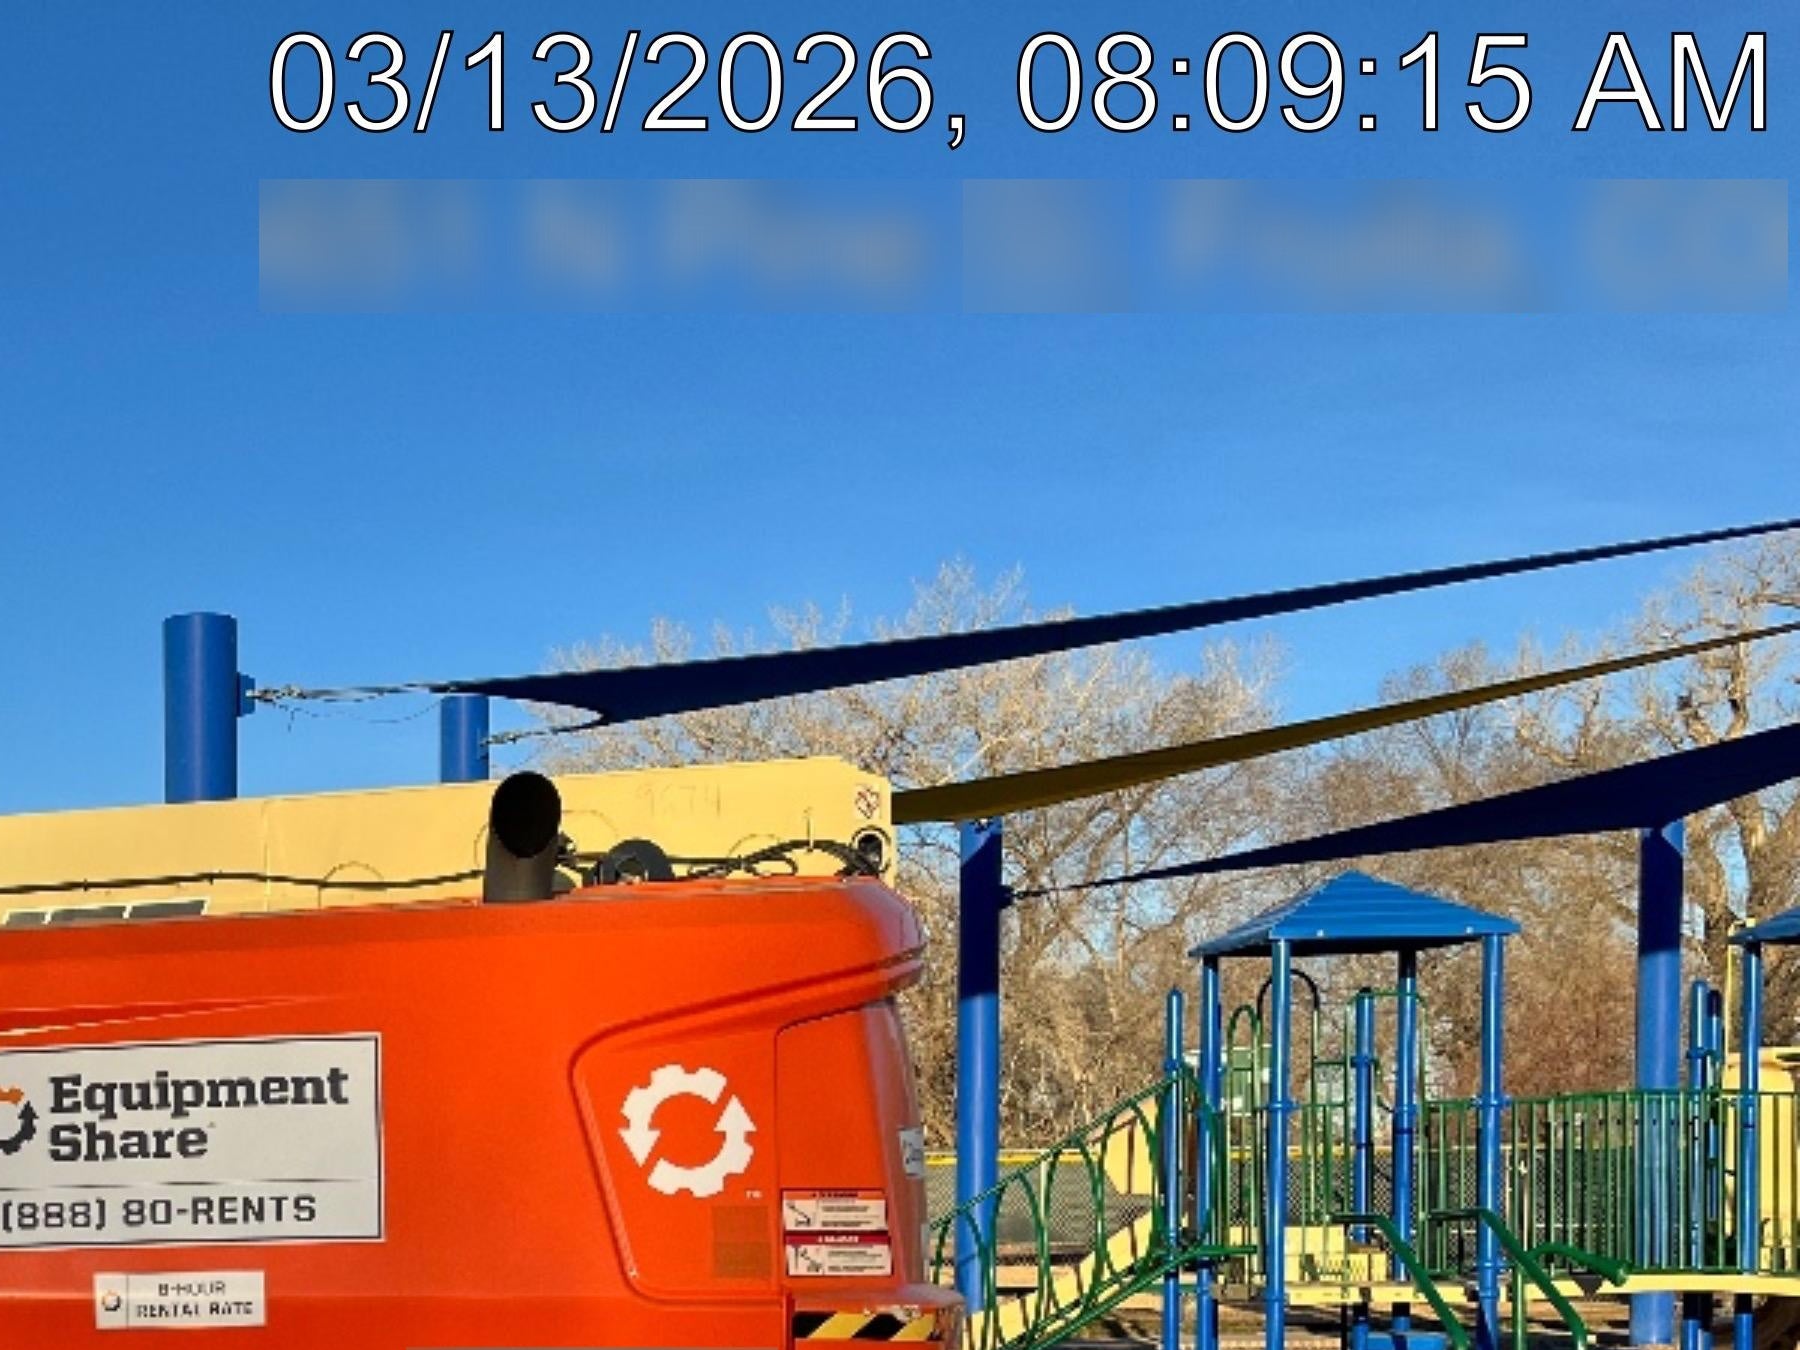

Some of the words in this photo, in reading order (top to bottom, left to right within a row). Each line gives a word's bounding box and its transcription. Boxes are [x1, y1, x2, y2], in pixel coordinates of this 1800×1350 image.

[48, 1067, 350, 1120] Equipment
[48, 1121, 209, 1162] Share
[2, 1199, 106, 1232] (888)
[122, 1195, 317, 1228] 80-RENTS
[208, 1301, 254, 1316] RATE
